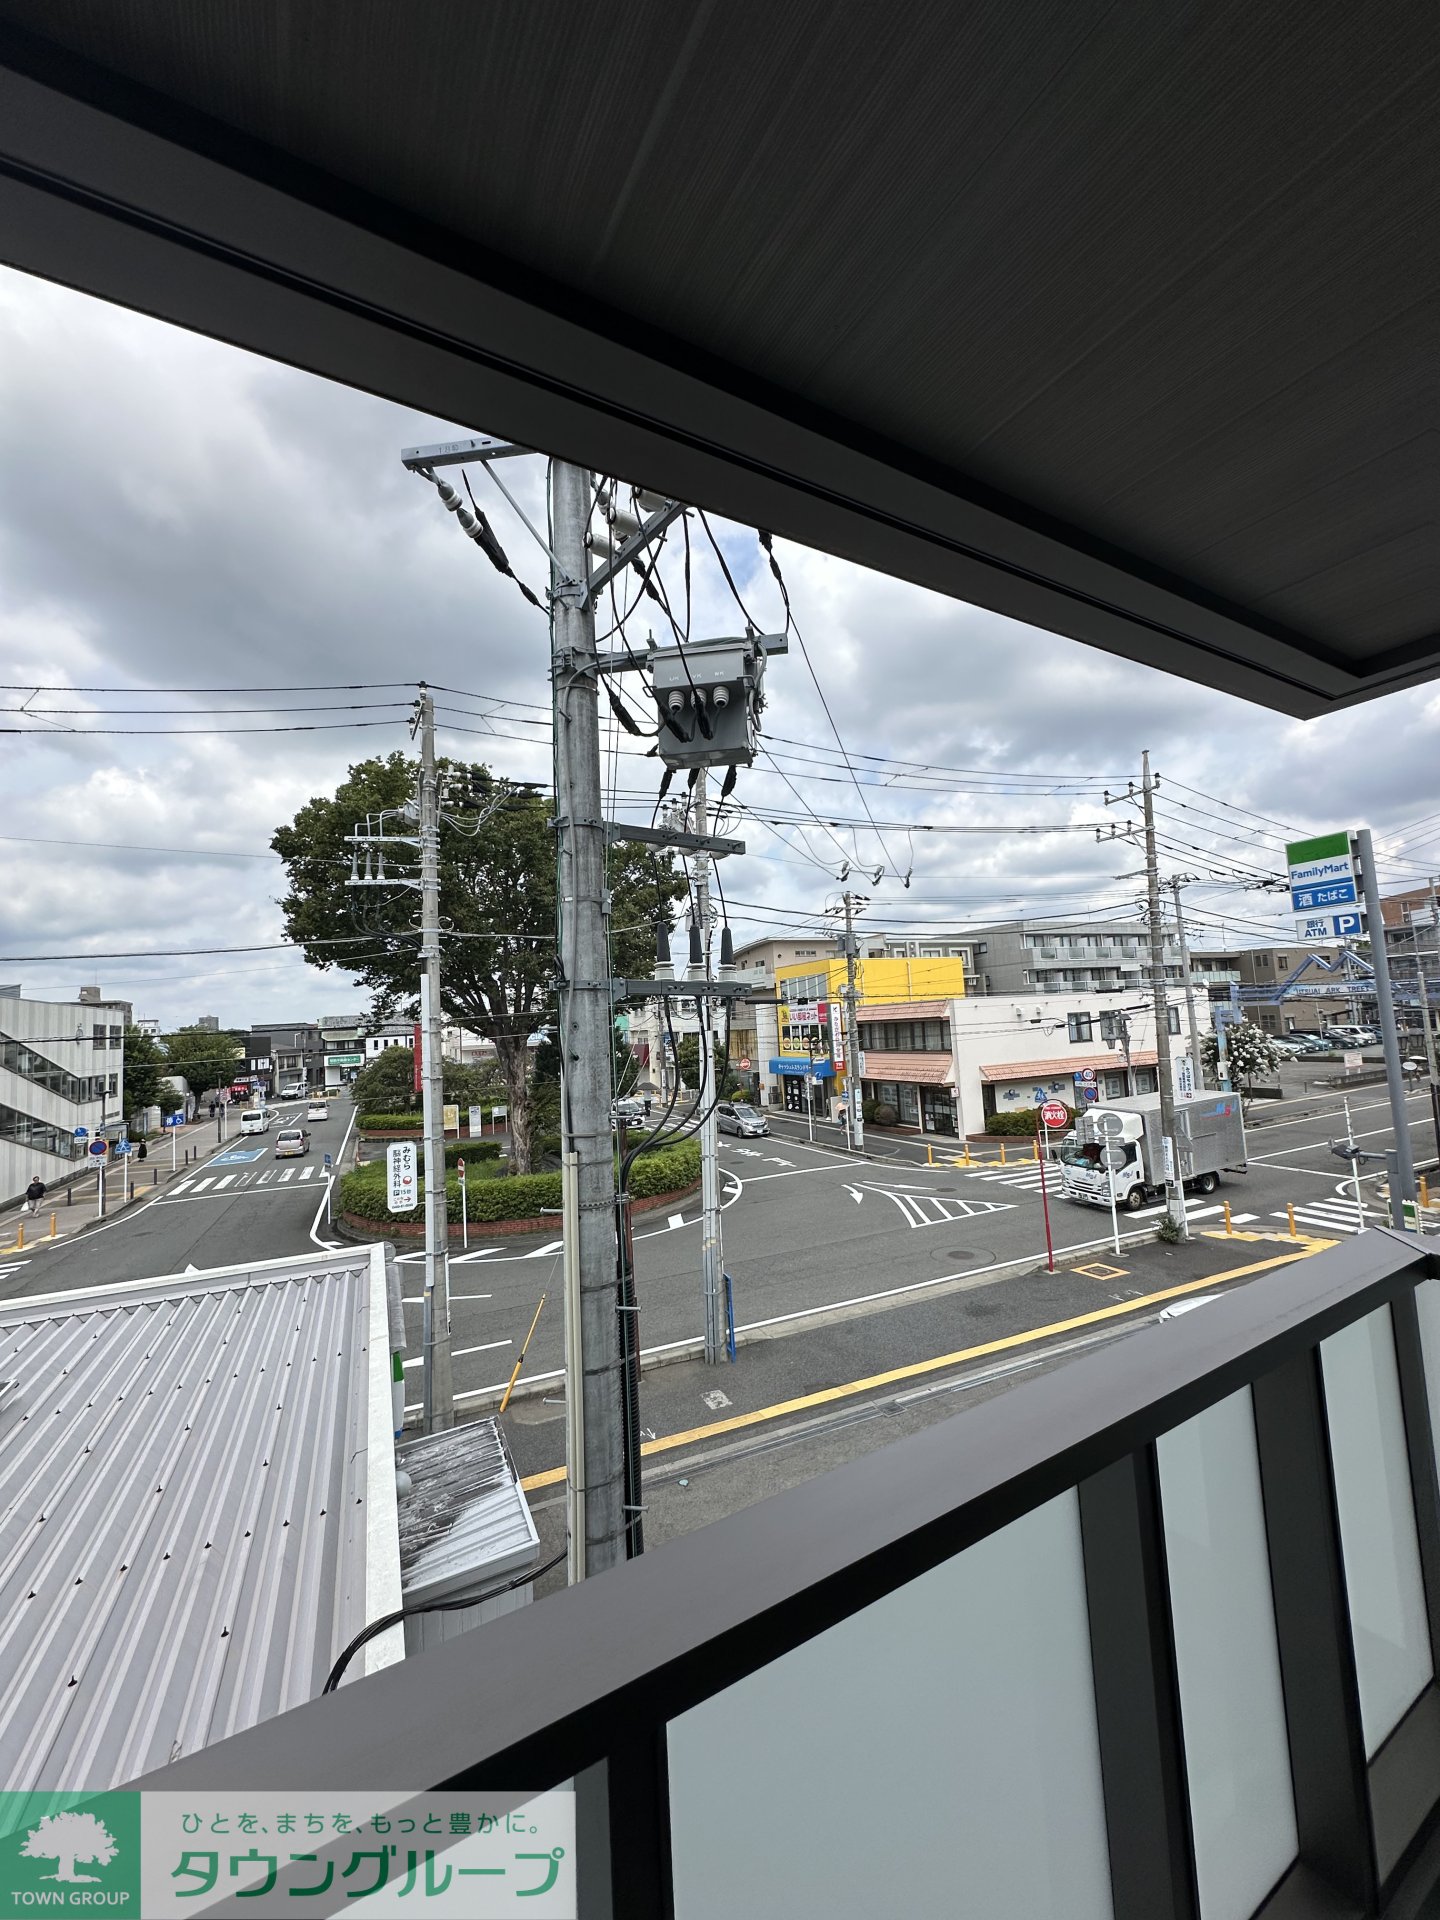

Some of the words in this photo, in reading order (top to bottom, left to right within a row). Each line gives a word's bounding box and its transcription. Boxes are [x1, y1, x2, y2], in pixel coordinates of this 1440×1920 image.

[1291, 862, 1349, 880] FamilyMart
[1298, 893, 1312, 906] 酒
[1317, 888, 1349, 903] たばこ
[1304, 927, 1328, 938] ATM
[1306, 918, 1325, 929] 銀行
[1338, 915, 1355, 933] P
[1043, 1110, 1065, 1121] 消火栓
[403, 1146, 411, 1170] みむら
[393, 1149, 401, 1188] 脳神経外科
